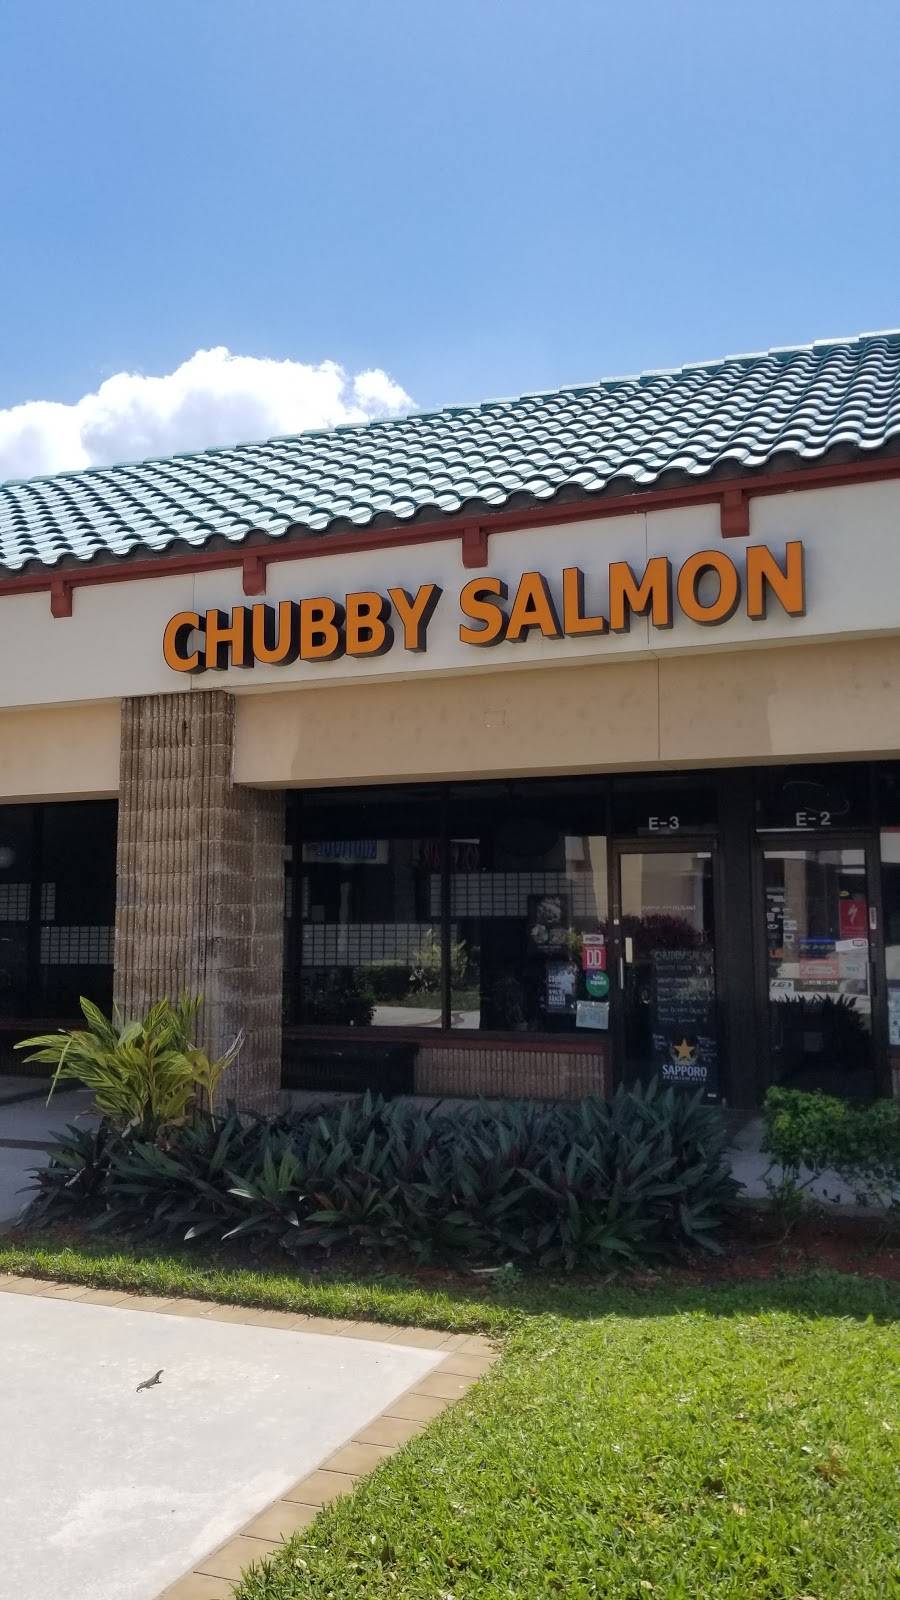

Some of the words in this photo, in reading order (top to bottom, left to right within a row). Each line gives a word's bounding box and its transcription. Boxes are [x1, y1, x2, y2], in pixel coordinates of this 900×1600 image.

[163, 583, 442, 673] CHUBBY
[459, 541, 805, 646] SALMON
[648, 816, 680, 831] E-3
[795, 811, 831, 827] E-2
[662, 1064, 707, 1078] SAPPORO
